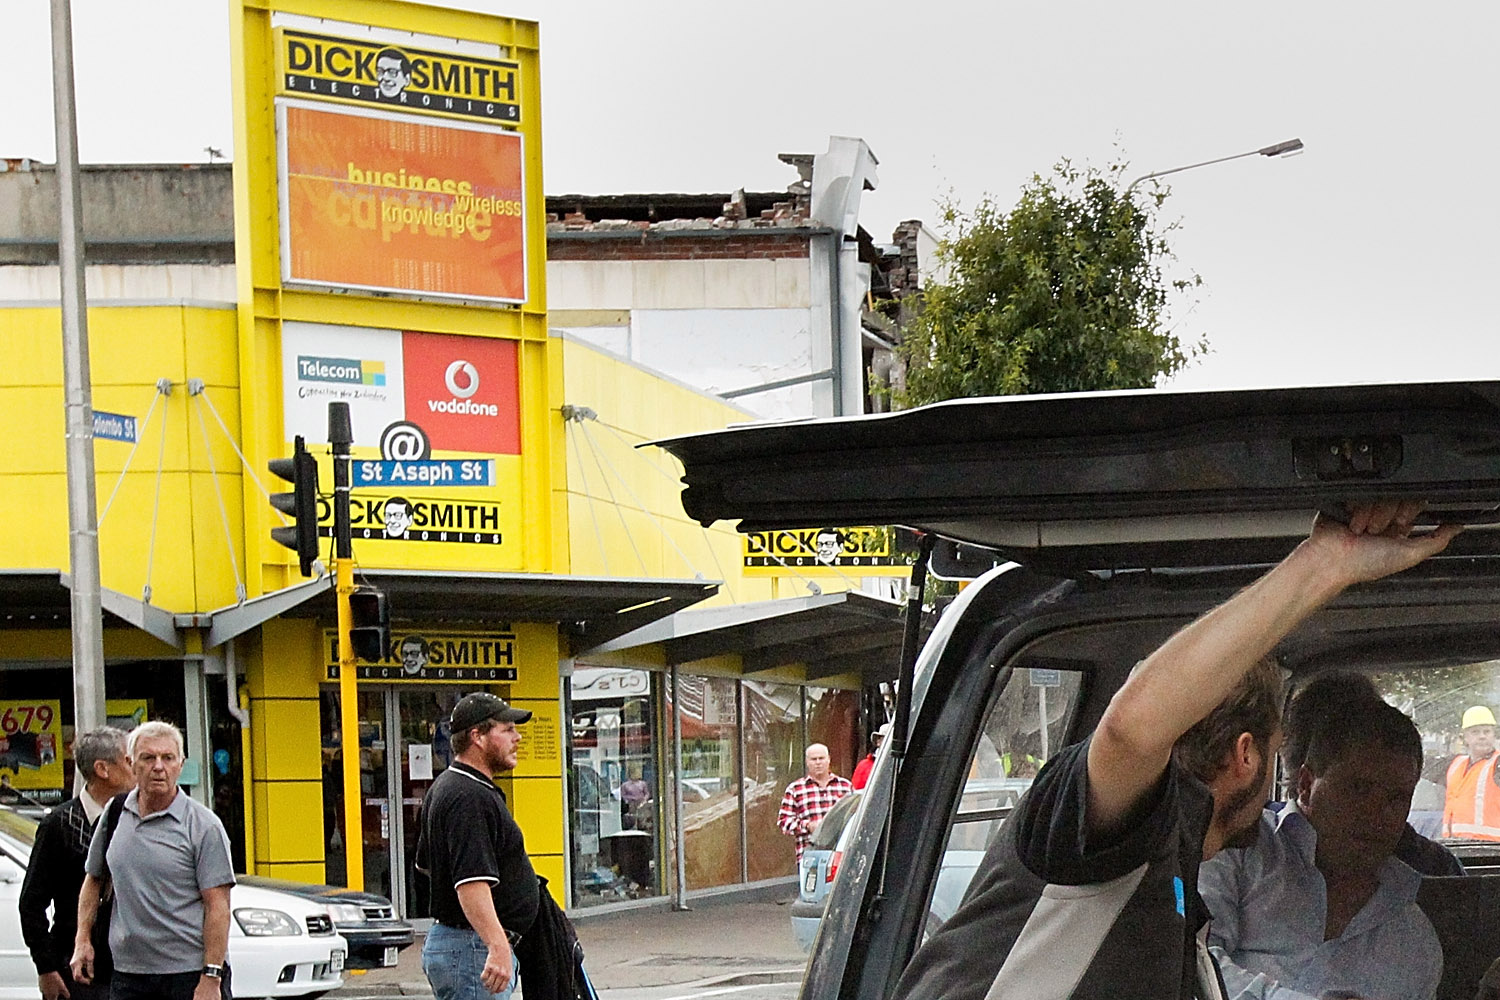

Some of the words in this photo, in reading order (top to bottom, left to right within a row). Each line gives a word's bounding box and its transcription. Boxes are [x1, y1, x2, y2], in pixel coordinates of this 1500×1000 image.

[288, 40, 377, 81] DICK
[410, 58, 515, 101] SMITH
[288, 75, 516, 117] ELECTRONICS
[347, 161, 474, 197] business
[381, 200, 477, 234] knowledge
[454, 194, 522, 217] wireless
[299, 359, 361, 380] Telecom
[427, 398, 498, 417] vodafone
[361, 461, 383, 482] St
[390, 462, 453, 486] Asaph
[460, 461, 482, 481] St
[317, 498, 384, 524] DCK
[413, 502, 499, 530] SMITH
[747, 531, 818, 554] DICK
[746, 556, 915, 567] ELECTRONIC
[428, 640, 513, 665] SMITH
[330, 666, 515, 680] EECTRONICS
[2, 705, 54, 735] 679
